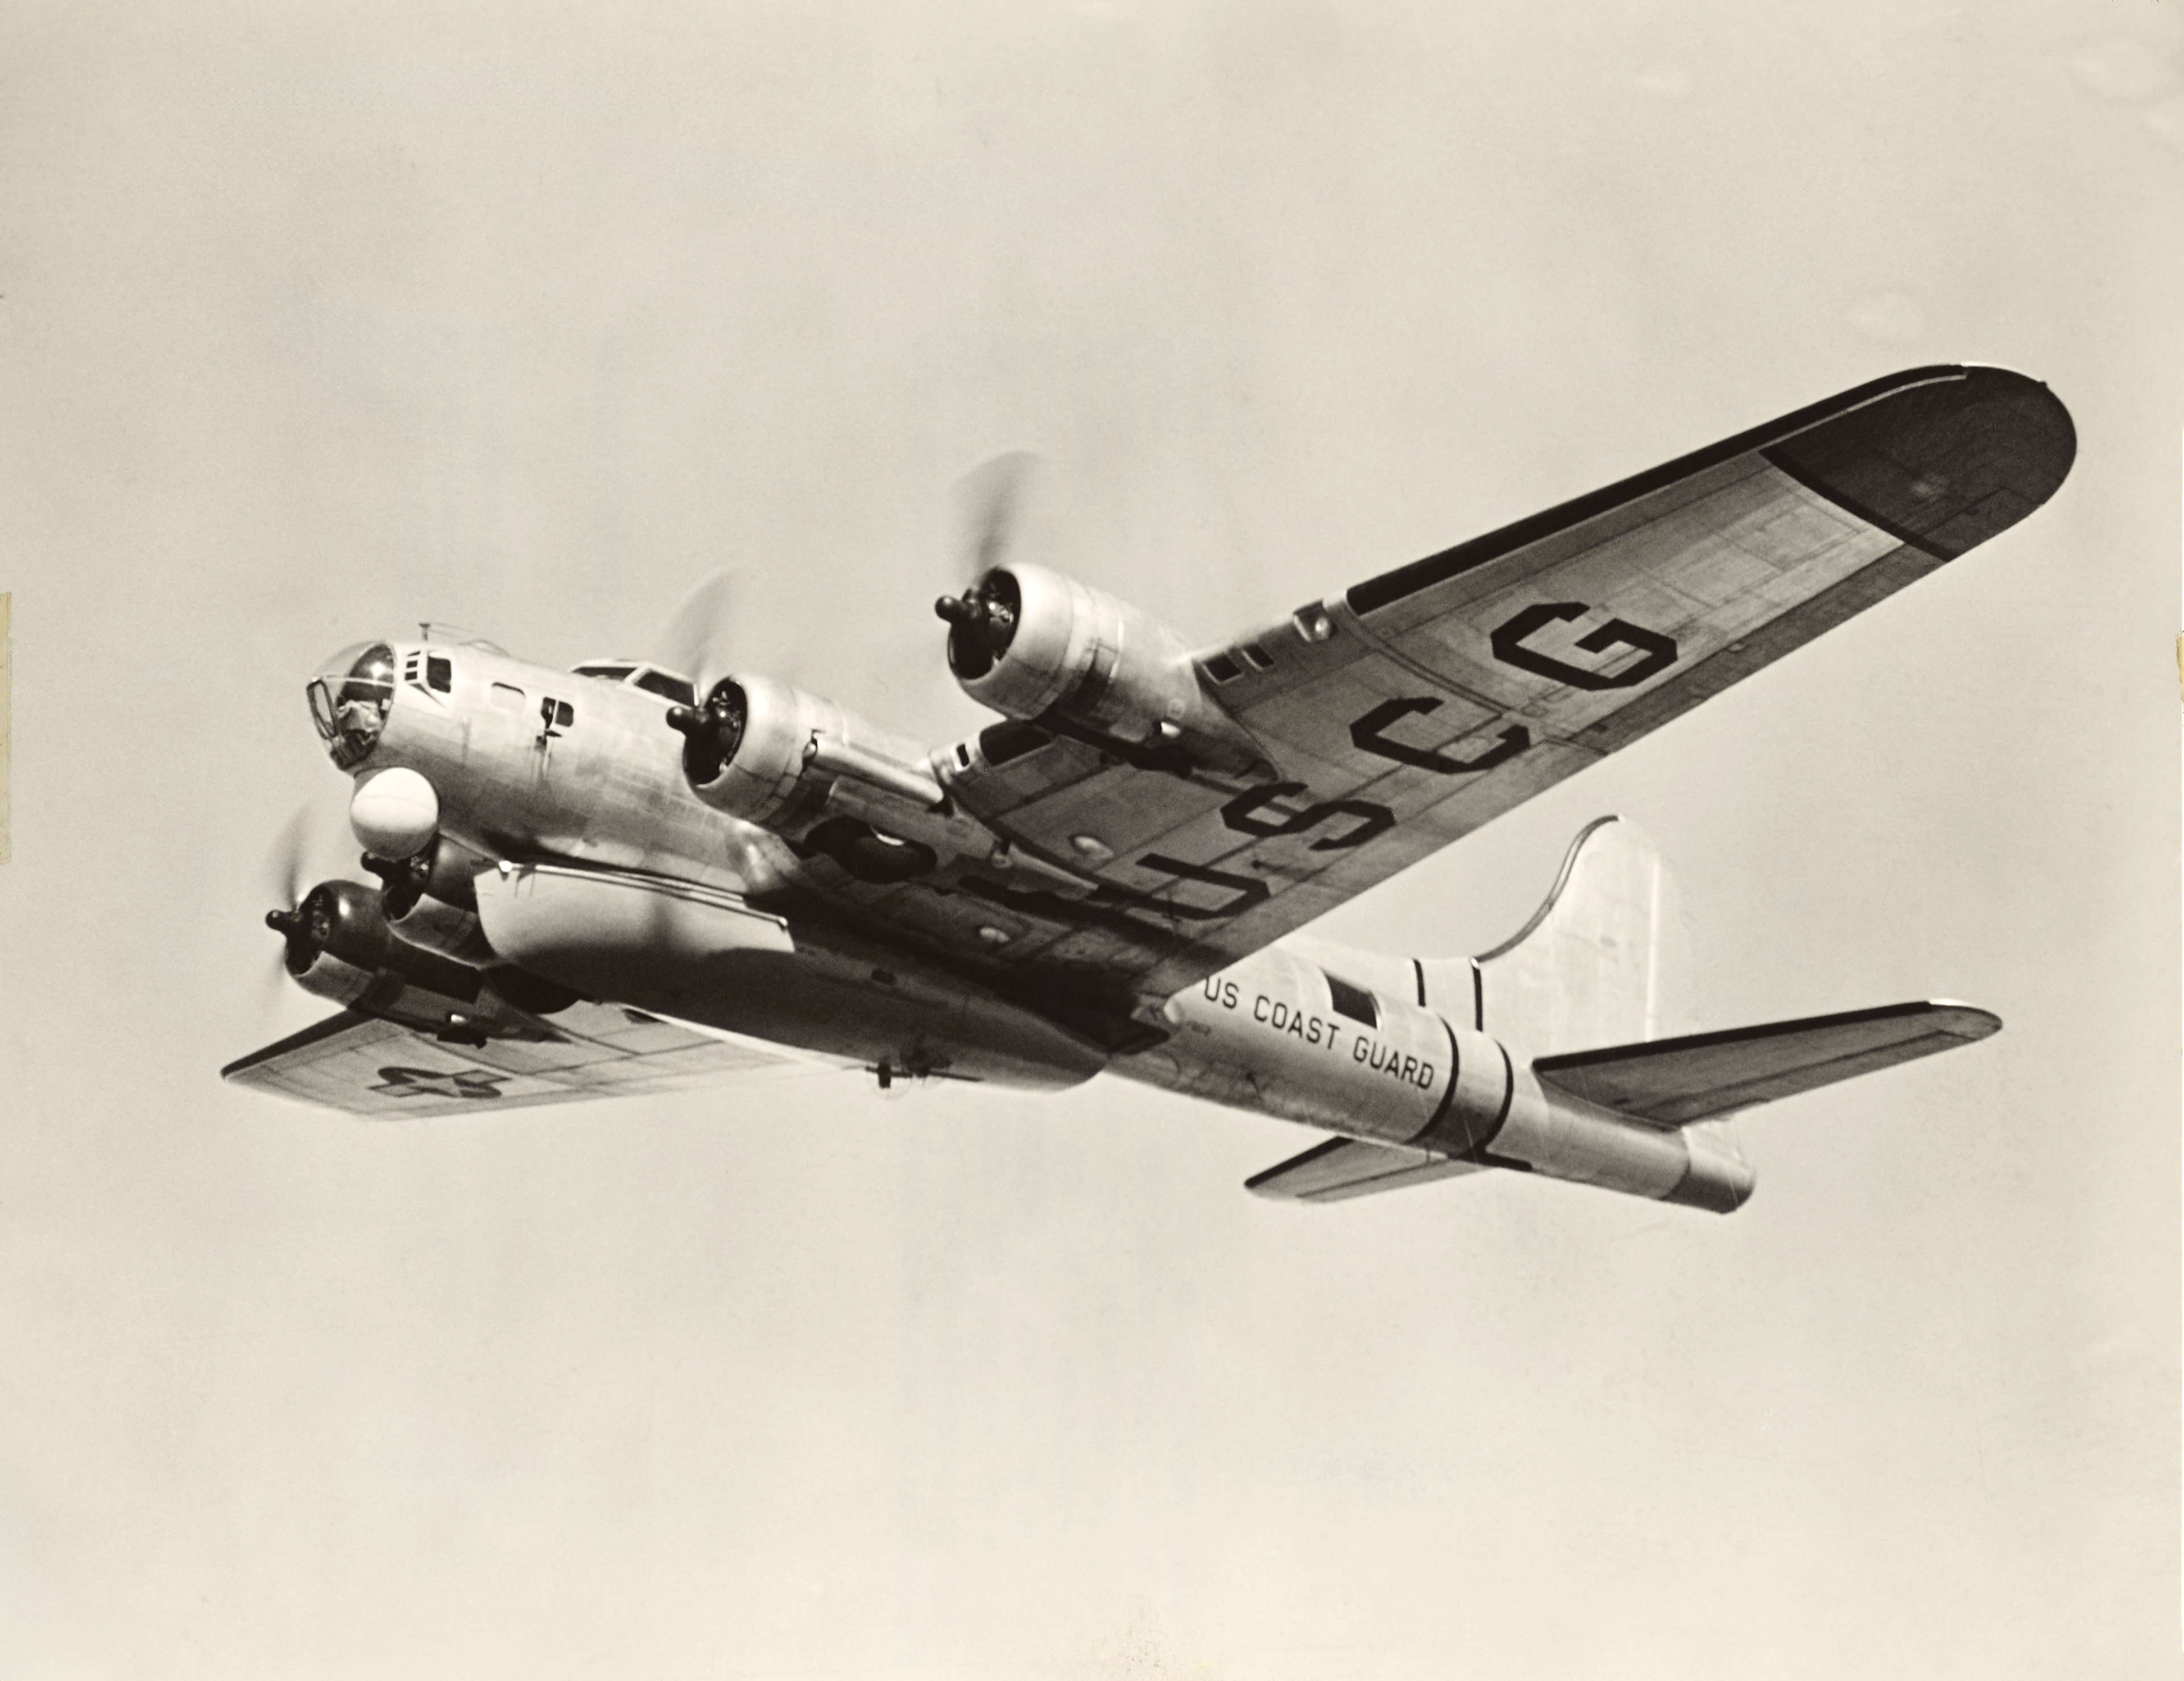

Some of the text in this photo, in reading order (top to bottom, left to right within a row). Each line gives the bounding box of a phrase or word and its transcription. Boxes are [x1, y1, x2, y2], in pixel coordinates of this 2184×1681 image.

[1092, 601, 1678, 920] USCG
[1204, 977, 1434, 1090] US COAST GUARD
